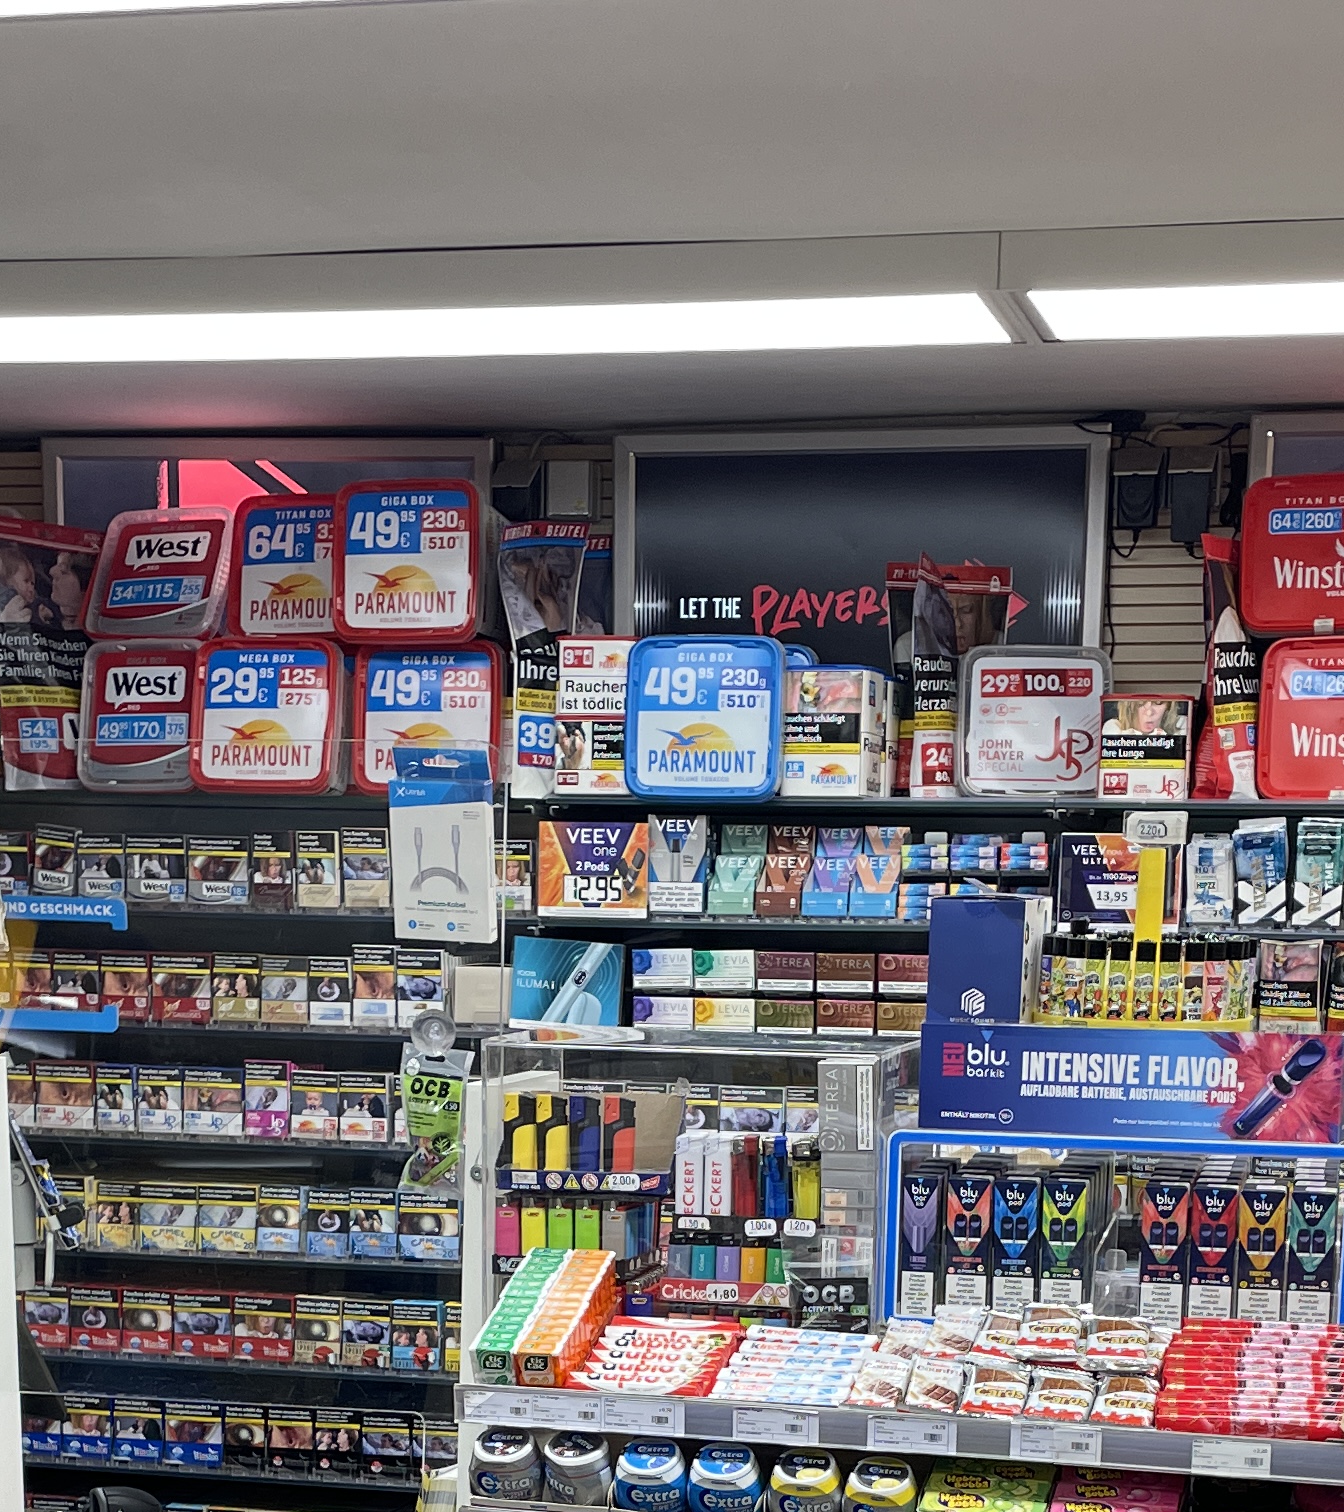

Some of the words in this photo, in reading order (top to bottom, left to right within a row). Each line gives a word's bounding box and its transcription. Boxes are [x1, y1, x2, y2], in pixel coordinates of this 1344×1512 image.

[381, 496, 407, 506] GIGA
[411, 495, 434, 506] BOX
[275, 510, 305, 520] TITAN
[309, 509, 332, 519] BOX
[135, 535, 201, 559] West
[355, 590, 457, 614] PARAMOUNT
[680, 598, 706, 619] LET
[712, 598, 741, 618] THE
[239, 653, 268, 664] MEGA
[272, 653, 295, 663] BOX
[678, 652, 705, 663] GIGA
[710, 652, 733, 662] BOX
[112, 672, 178, 696] West
[978, 738, 1013, 750] JOHN
[212, 745, 313, 767] PARAMOUNT
[648, 750, 756, 774] PARAMOUNT
[978, 750, 1024, 762] PLAYER
[977, 761, 1024, 772] SPECIAL
[655, 819, 698, 833] VEEV
[566, 828, 620, 845] VEEV
[593, 846, 618, 858] one
[1072, 845, 1107, 855] VEEV
[576, 861, 582, 872] 2
[584, 860, 610, 873] Pods
[718, 855, 759, 868] VEEV
[767, 855, 807, 869] VEEV
[1096, 891, 1128, 903] 13,95
[30, 902, 116, 916] GESCHMACK.
[656, 954, 688, 965] LEVIA
[775, 958, 811, 968] TEREA
[942, 1042, 965, 1076] NEU
[1021, 1051, 1140, 1085] INTENSIVE
[1147, 1056, 1245, 1092] FLAVOR,
[410, 1077, 450, 1099] OCB
[1020, 1084, 1079, 1098] AUFLADBARE
[1081, 1086, 1126, 1100] BATTERIE,
[1129, 1089, 1208, 1102] AUSTAUSCHBARE
[1211, 1090, 1236, 1103] PODS
[683, 1161, 695, 1214] ECKERT
[662, 1283, 707, 1299] Cricke
[802, 1284, 855, 1304] OCB
[631, 1488, 680, 1503] extra
